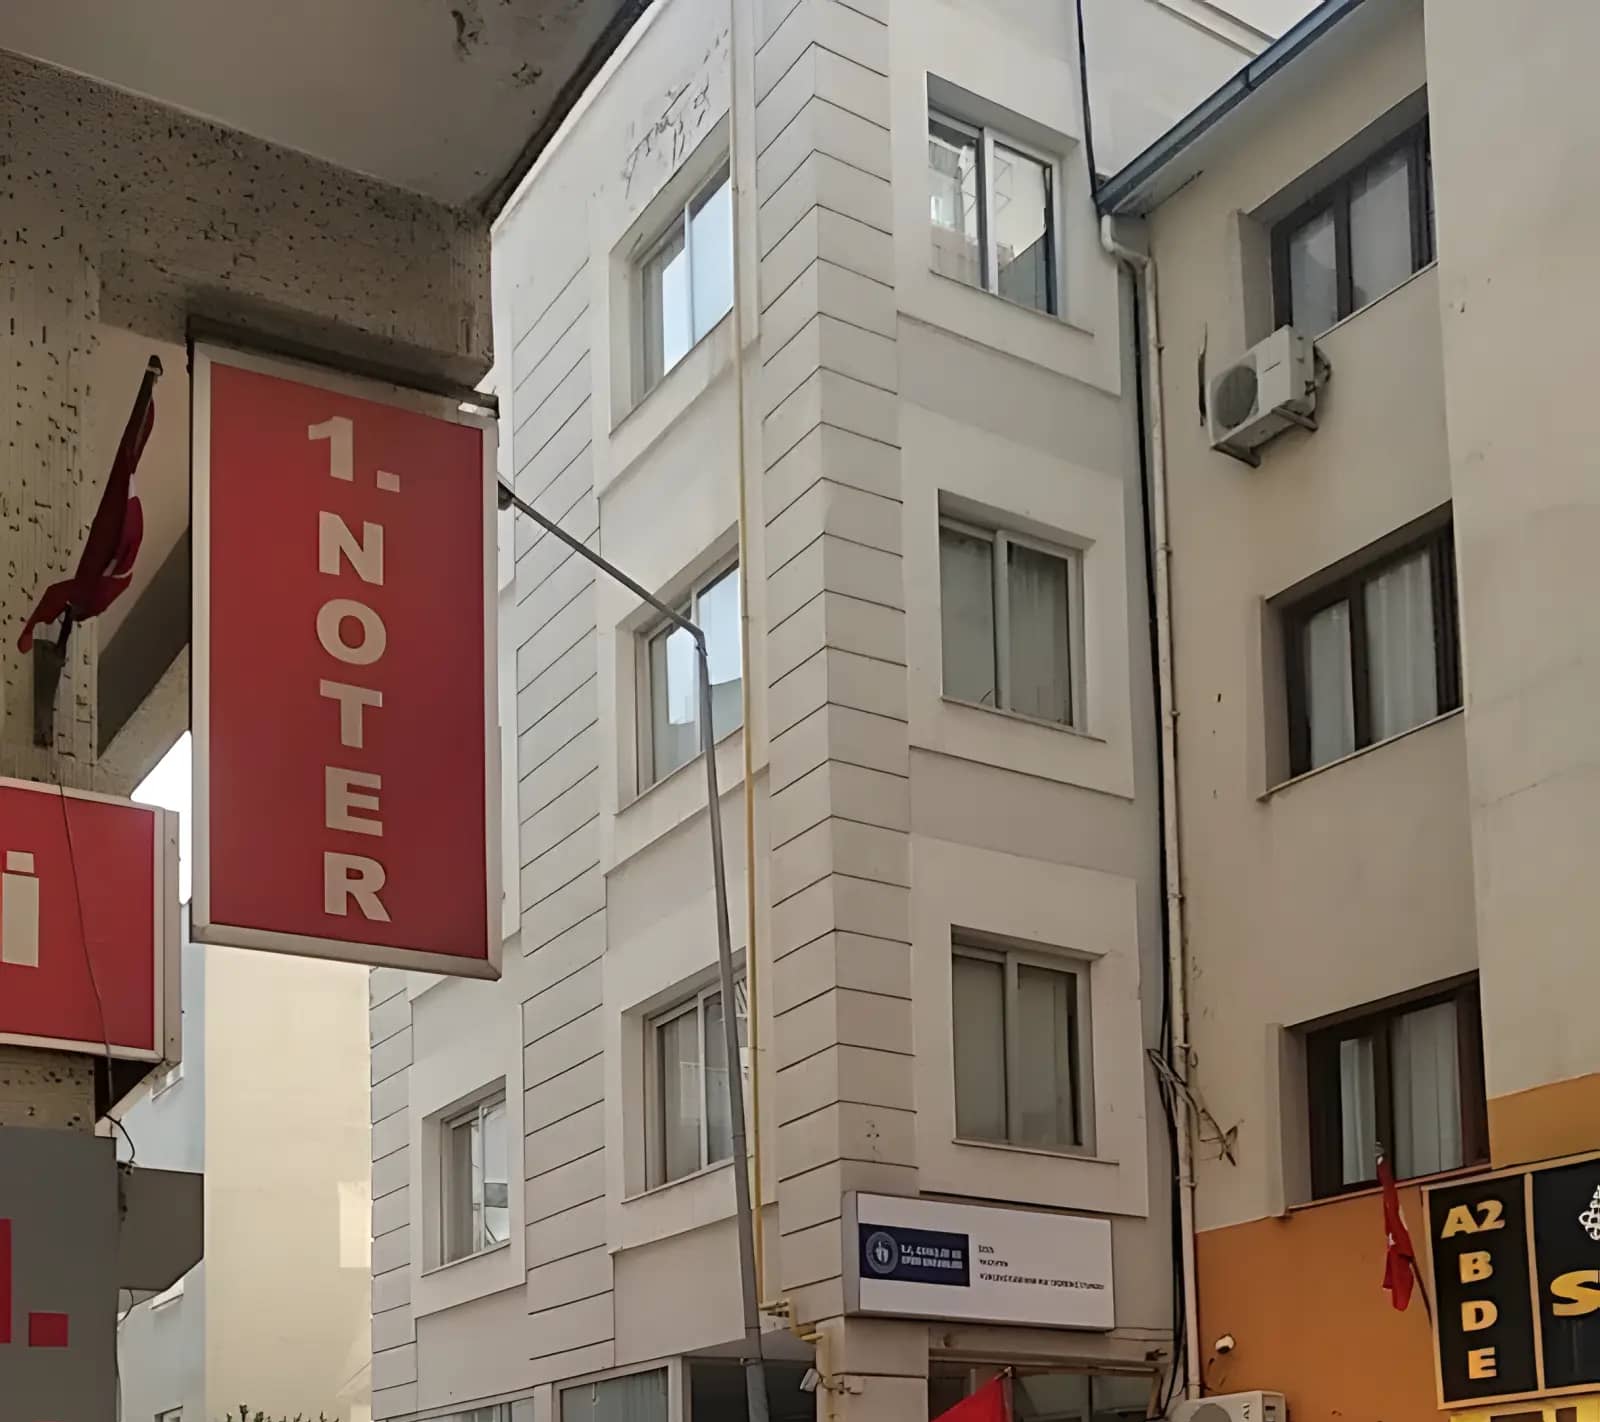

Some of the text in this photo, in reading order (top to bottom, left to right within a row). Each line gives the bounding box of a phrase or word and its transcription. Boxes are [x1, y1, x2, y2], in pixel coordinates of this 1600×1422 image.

[307, 415, 401, 493] 1.
[315, 510, 392, 925] NOTER
[1441, 1200, 1506, 1239] A2
[1459, 1251, 1494, 1284] B
[1461, 1300, 1498, 1332] D
[1468, 1347, 1497, 1379] E
